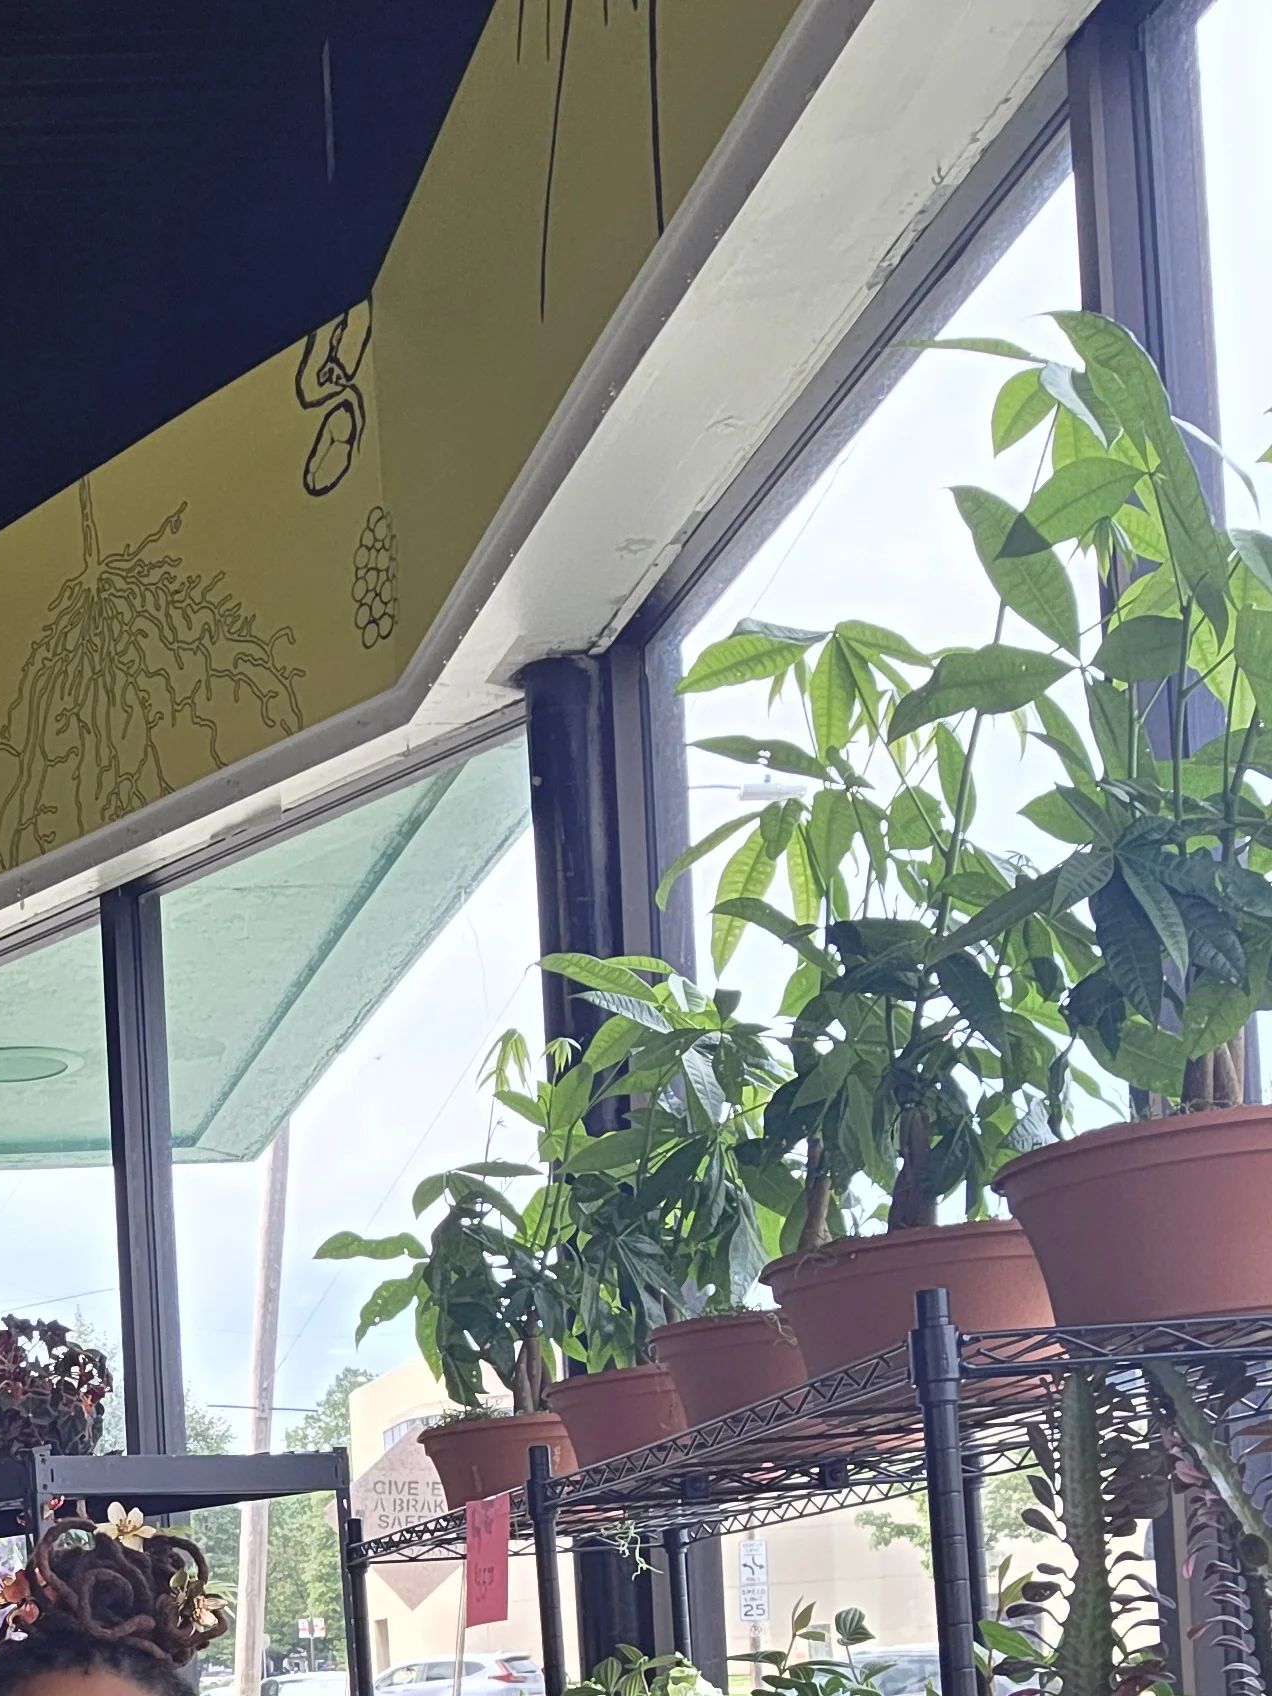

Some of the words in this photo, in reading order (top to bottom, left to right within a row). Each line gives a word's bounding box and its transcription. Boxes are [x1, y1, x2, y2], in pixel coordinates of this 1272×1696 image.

[373, 1480, 419, 1496] GIVE
[426, 1481, 442, 1496] 'E
[373, 1498, 386, 1512] A
[393, 1497, 445, 1513] BRAK
[378, 1514, 434, 1529] SAF
[743, 1603, 766, 1617] 25
